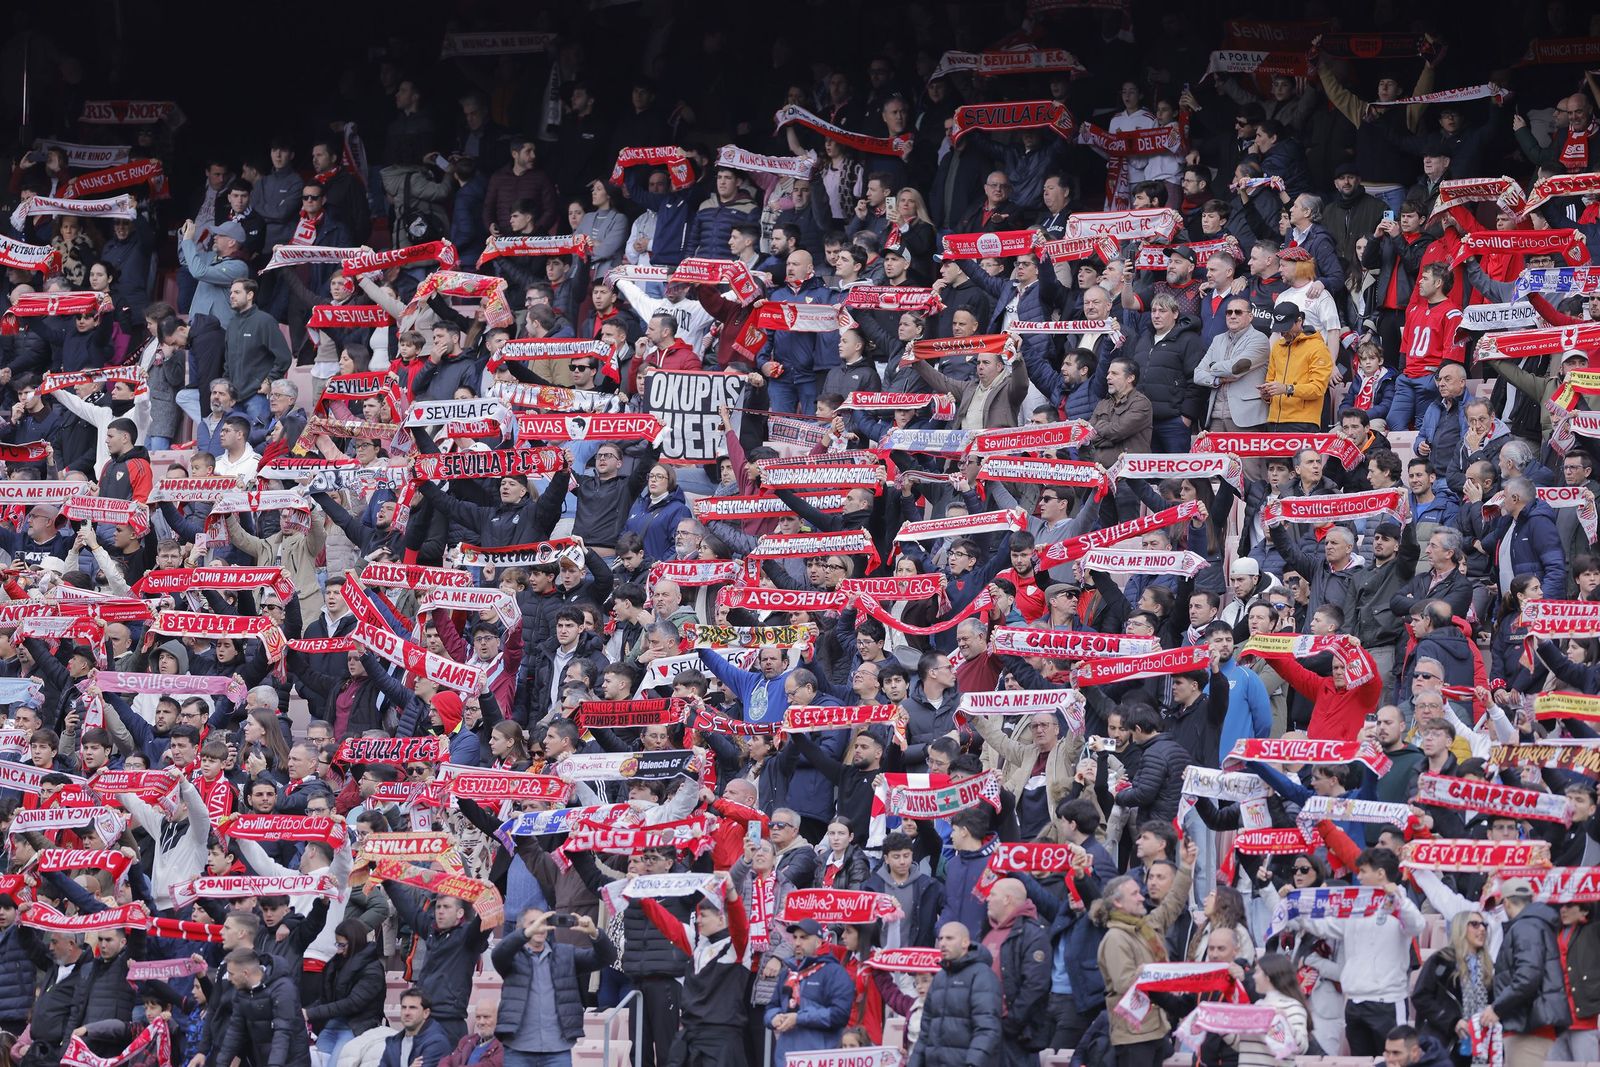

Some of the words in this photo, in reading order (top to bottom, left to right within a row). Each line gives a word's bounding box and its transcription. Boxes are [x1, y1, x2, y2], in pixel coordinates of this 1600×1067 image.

[983, 53, 1031, 66] SEVILLA
[1229, 53, 1250, 61] POR
[1251, 54, 1262, 62] LA
[964, 106, 1031, 126] SEVILLA
[1138, 136, 1152, 151] DEL
[75, 151, 87, 160] ME
[88, 151, 112, 161] RINDO
[643, 148, 655, 159] TE
[80, 172, 115, 190] NUNCA
[116, 170, 128, 181] TE
[1089, 219, 1135, 236] Sevilla
[11, 243, 35, 256] FUTBOL
[279, 249, 318, 260] NUNCA
[348, 250, 386, 270] SEVILLA
[387, 248, 407, 262] FC
[634, 267, 667, 275] NUNC
[1562, 274, 1573, 284] 04
[334, 308, 375, 323] SEVILLA
[377, 309, 390, 323] FC
[1468, 309, 1498, 323] NUNCA
[1499, 309, 1509, 321] TE
[1511, 306, 1537, 320] RINDA
[1053, 320, 1069, 330] ME
[1072, 319, 1106, 330] RINDO
[1410, 327, 1431, 357] 10
[328, 377, 380, 394] SEVILLA
[649, 372, 741, 412] OKUPAS
[426, 403, 477, 421] SEVILLA
[480, 402, 498, 416] FC
[447, 421, 470, 434] FINAL
[470, 421, 490, 433] COPA
[520, 418, 562, 434] NAVAS
[592, 417, 656, 434] LEYENDA
[649, 411, 722, 459] UER
[951, 431, 962, 443] 04
[983, 431, 1064, 450] SevillaFútbolClub
[445, 452, 502, 476] SEVILLA
[506, 450, 537, 472] F.C.
[1128, 458, 1224, 474] SUPERCOPA
[26, 487, 43, 499] ME
[45, 486, 80, 498] RINDO
[71, 496, 97, 508] SOMOS
[97, 498, 107, 509] DE
[107, 499, 130, 511] TODOS
[717, 499, 755, 514] SEVILLA
[819, 495, 842, 509] 1905
[1078, 518, 1141, 552] SEVILLA
[1143, 513, 1165, 532] FC
[1088, 554, 1126, 568] NUNCA
[1126, 555, 1143, 568] ME
[1144, 554, 1177, 568] RINDO
[147, 573, 194, 589] SevillaFút
[361, 563, 407, 582] BIRIS
[840, 577, 896, 594] SEVILLA
[909, 577, 936, 593] F.C.
[451, 590, 467, 603] ME
[1541, 603, 1600, 617] SEVILLA
[166, 615, 237, 632] SEVILLA
[1026, 631, 1121, 654] CAMPEON
[728, 651, 745, 665] FC
[1043, 648, 1081, 656] SEVILLA
[116, 671, 210, 690] SevillaGirls
[970, 693, 1012, 708] NUNCA
[1012, 693, 1030, 707] ME
[1031, 692, 1068, 706] RINDO
[794, 706, 859, 726] SEVILLA
[870, 704, 889, 719] F.C.
[349, 738, 401, 760] SEVILLA
[404, 737, 434, 758] F.C.
[1260, 740, 1318, 758] SEVILLA
[1320, 740, 1344, 758] FC
[638, 759, 670, 770] Valencia
[670, 757, 682, 769] CF
[458, 777, 509, 794] SEVILLA
[517, 778, 543, 794] F.C.
[905, 794, 939, 813] ULTRAS
[1447, 781, 1540, 809] CAMPEON
[16, 810, 47, 825] RINDO
[48, 808, 66, 822] ME
[236, 814, 330, 831] SevillaFútbolClub
[553, 815, 565, 825] 04
[365, 839, 418, 854] SEVILLA
[1417, 844, 1493, 864] SEVILLA
[1503, 845, 1527, 864] F.C.
[41, 848, 93, 870] SEVILLA
[96, 850, 118, 869] FC
[997, 844, 1029, 870] FC
[134, 966, 182, 981] SEVILLISTA
